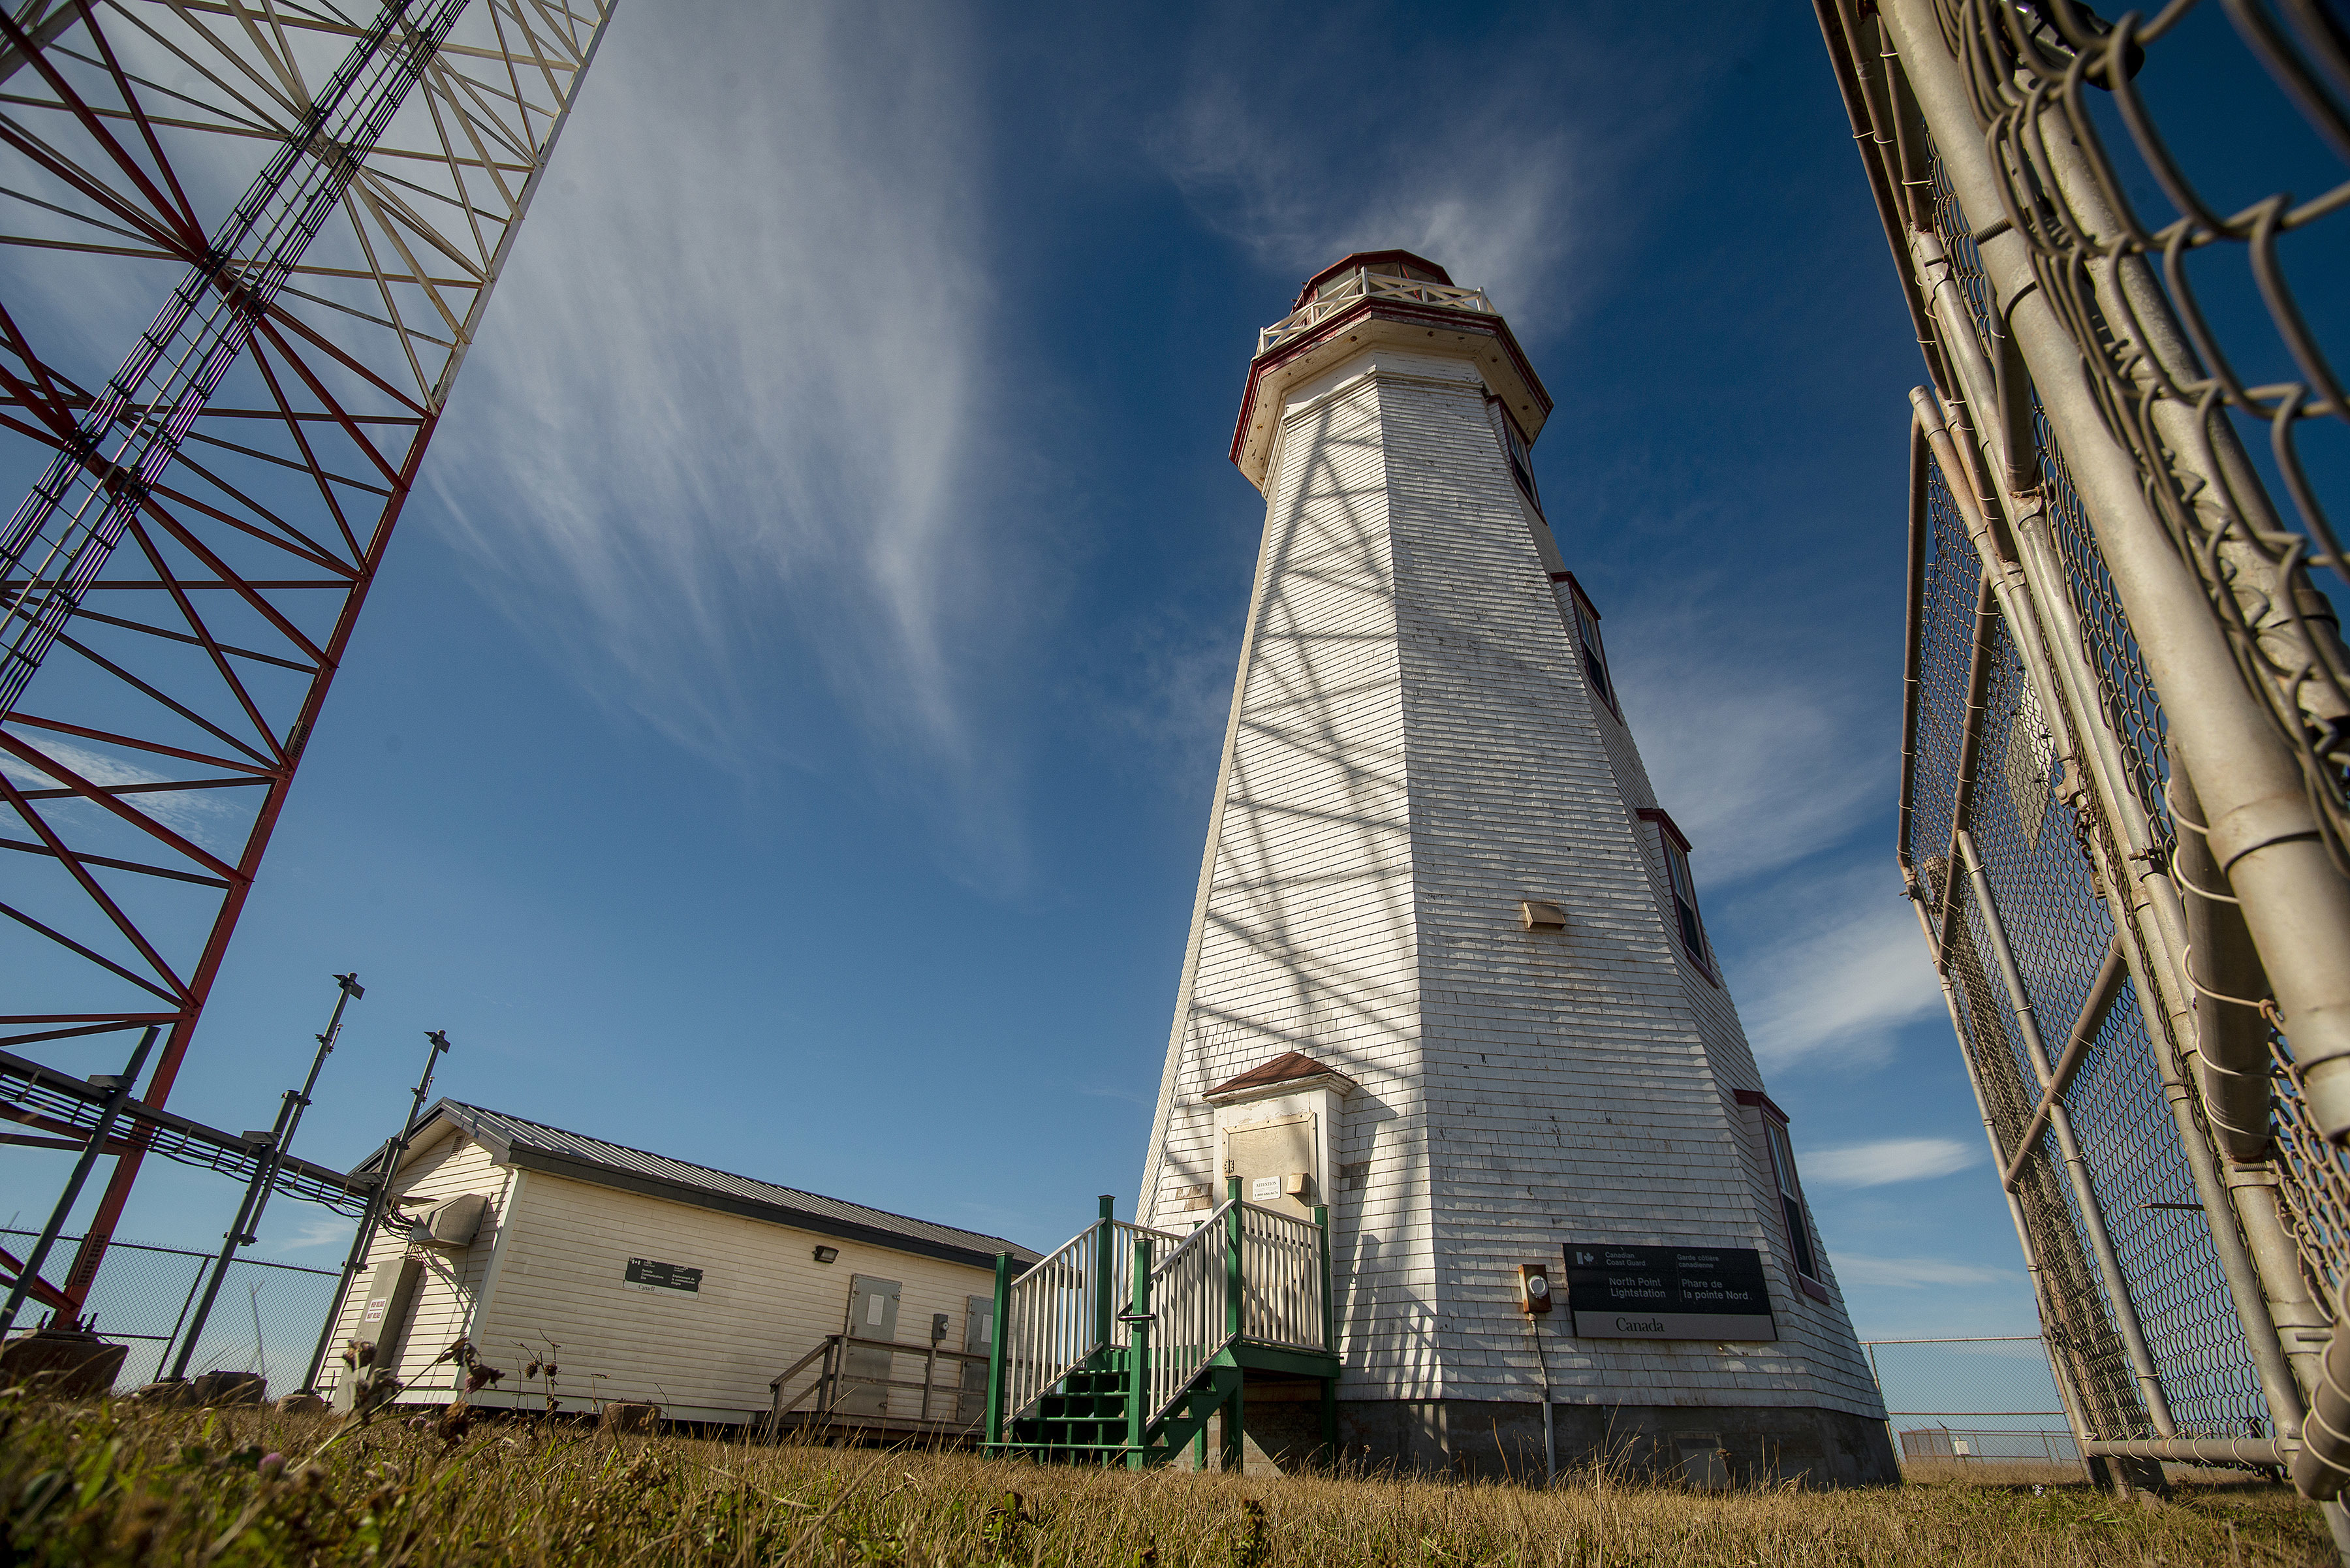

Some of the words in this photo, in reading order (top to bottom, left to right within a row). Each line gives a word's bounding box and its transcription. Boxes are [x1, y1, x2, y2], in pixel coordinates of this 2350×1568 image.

[1608, 1277, 1635, 1286] North
[1637, 1278, 1661, 1287] Point
[1682, 1278, 1708, 1288] Phare
[1610, 1288, 1666, 1298] Lightstation
[1683, 1289, 1692, 1298] la
[1695, 1290, 1724, 1300] pointe
[1725, 1291, 1749, 1300] Nord
[1615, 1317, 1665, 1332] Canada
